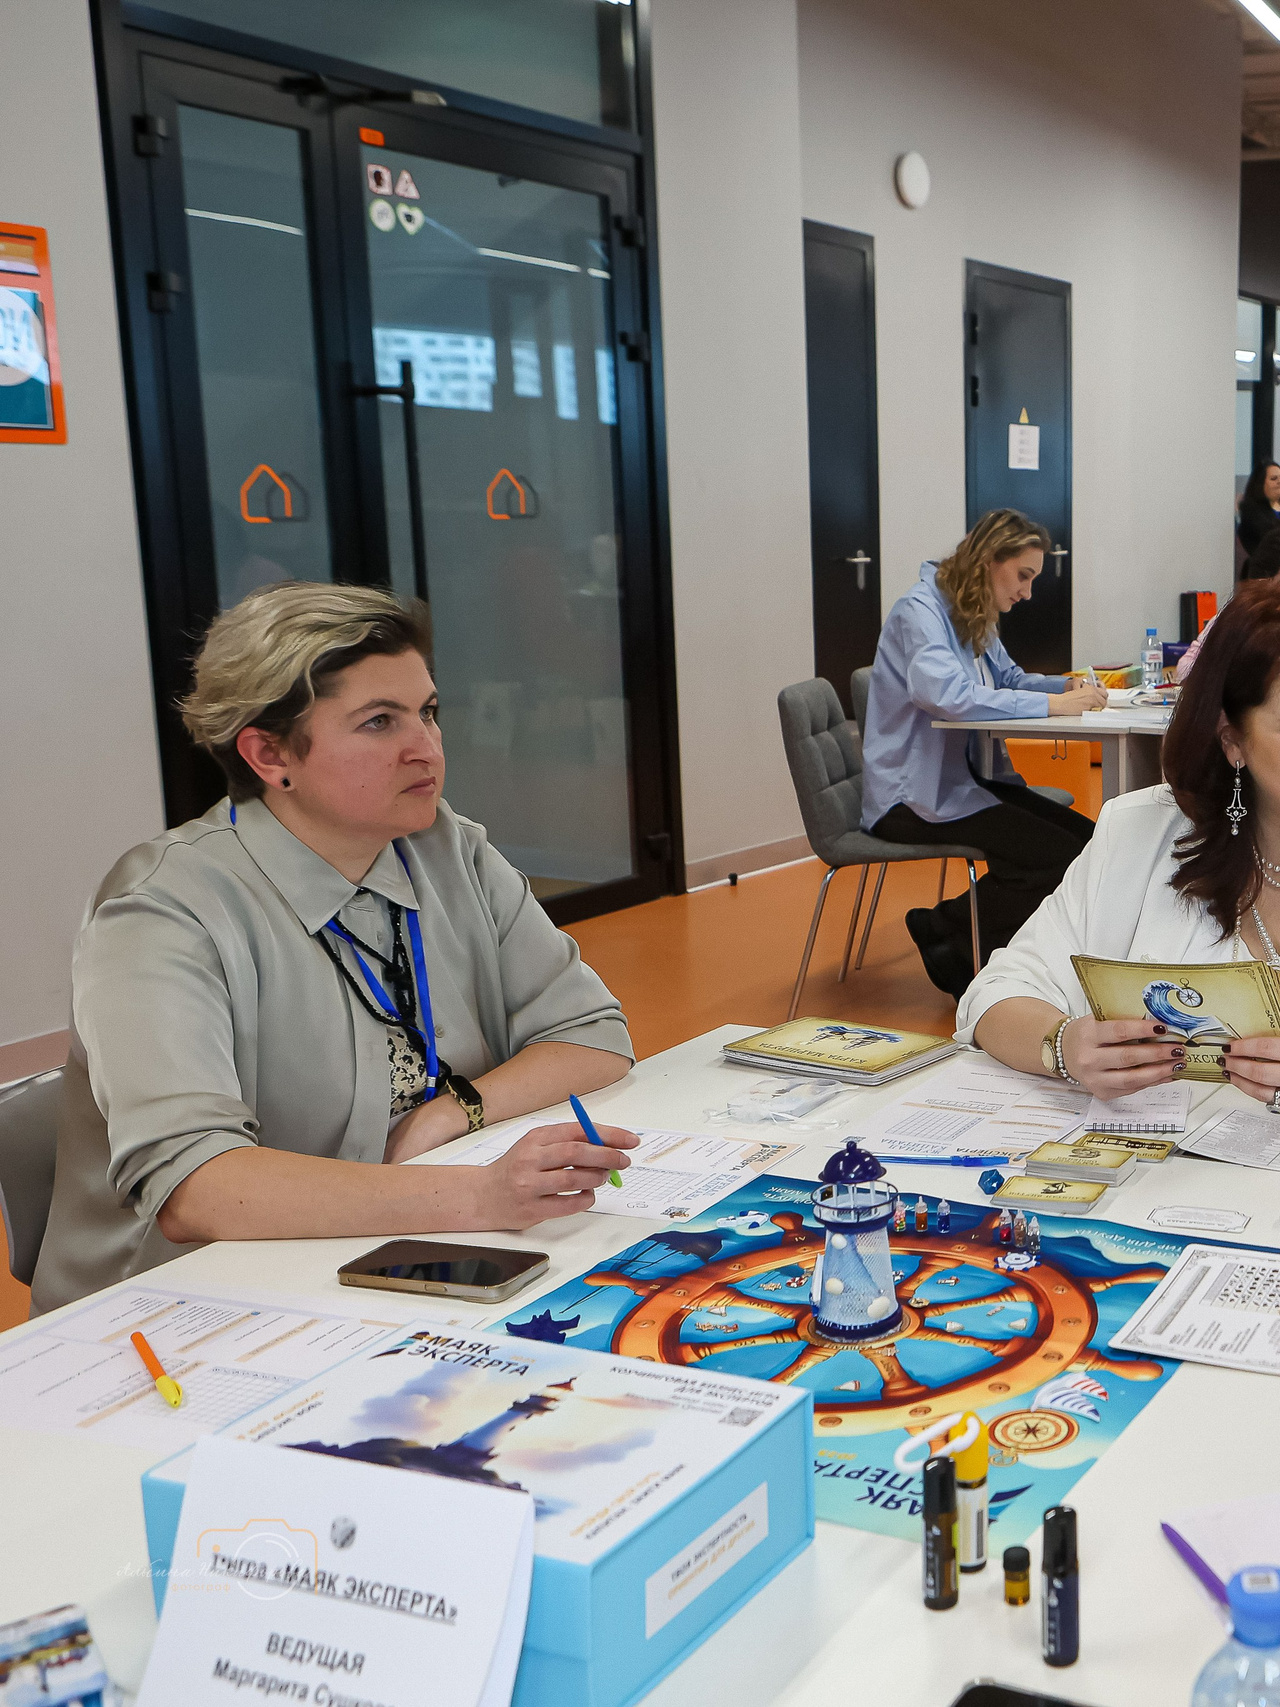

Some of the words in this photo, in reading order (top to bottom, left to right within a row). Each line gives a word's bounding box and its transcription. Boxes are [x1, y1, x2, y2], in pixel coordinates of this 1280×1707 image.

[759, 1043, 825, 1058] МАРШРУТА
[828, 1054, 867, 1065] КАРТА
[1185, 1054, 1223, 1063] ЭКСП
[1094, 1239, 1181, 1258] СПЕРТНОСТЬ
[407, 1345, 531, 1376] ЭКСПЕРТА
[425, 1334, 500, 1356] МАЯК
[814, 1461, 923, 1496] СПЕРТА
[855, 1486, 923, 1517] АЯК
[343, 1578, 458, 1620] ЭКСПЕРТА»
[266, 1633, 365, 1676] ВЕДУЩАЯ
[212, 1656, 310, 1702] Маргарита
